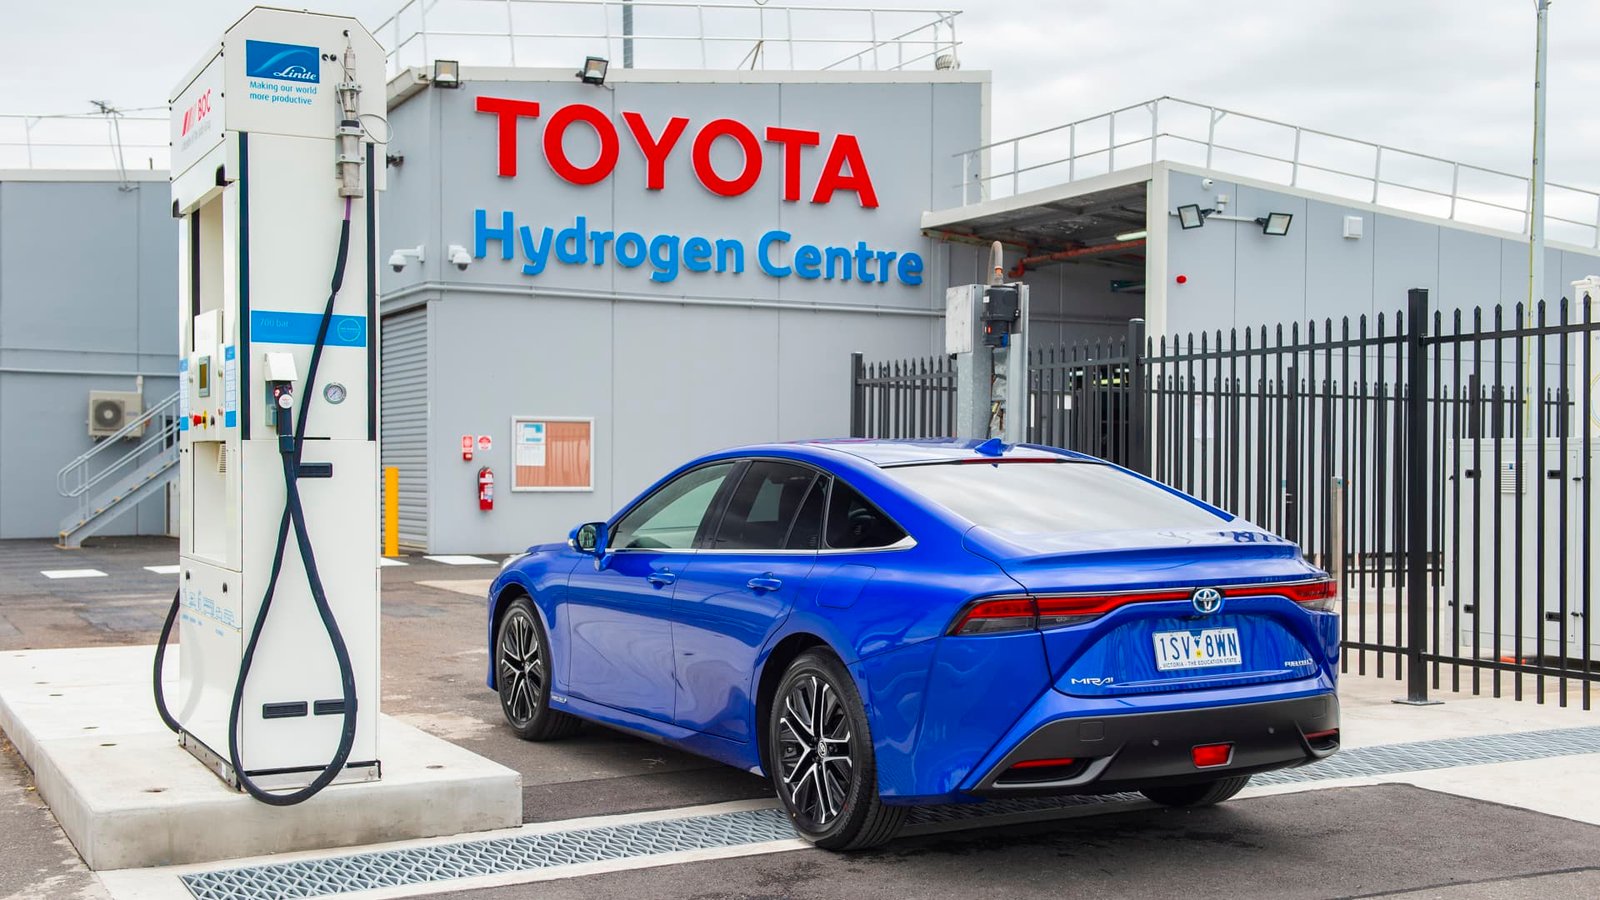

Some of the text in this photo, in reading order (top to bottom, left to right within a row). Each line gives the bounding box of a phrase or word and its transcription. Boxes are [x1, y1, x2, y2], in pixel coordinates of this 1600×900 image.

[273, 65, 317, 80] Linde
[250, 81, 279, 92] Making
[296, 86, 317, 94] world
[272, 95, 313, 105] productive
[475, 96, 879, 208] TOYOTA
[474, 209, 924, 285] Hydrogen Centre
[1160, 633, 1237, 661] 1SV 8WN
[1071, 677, 1114, 686] MIRAI
